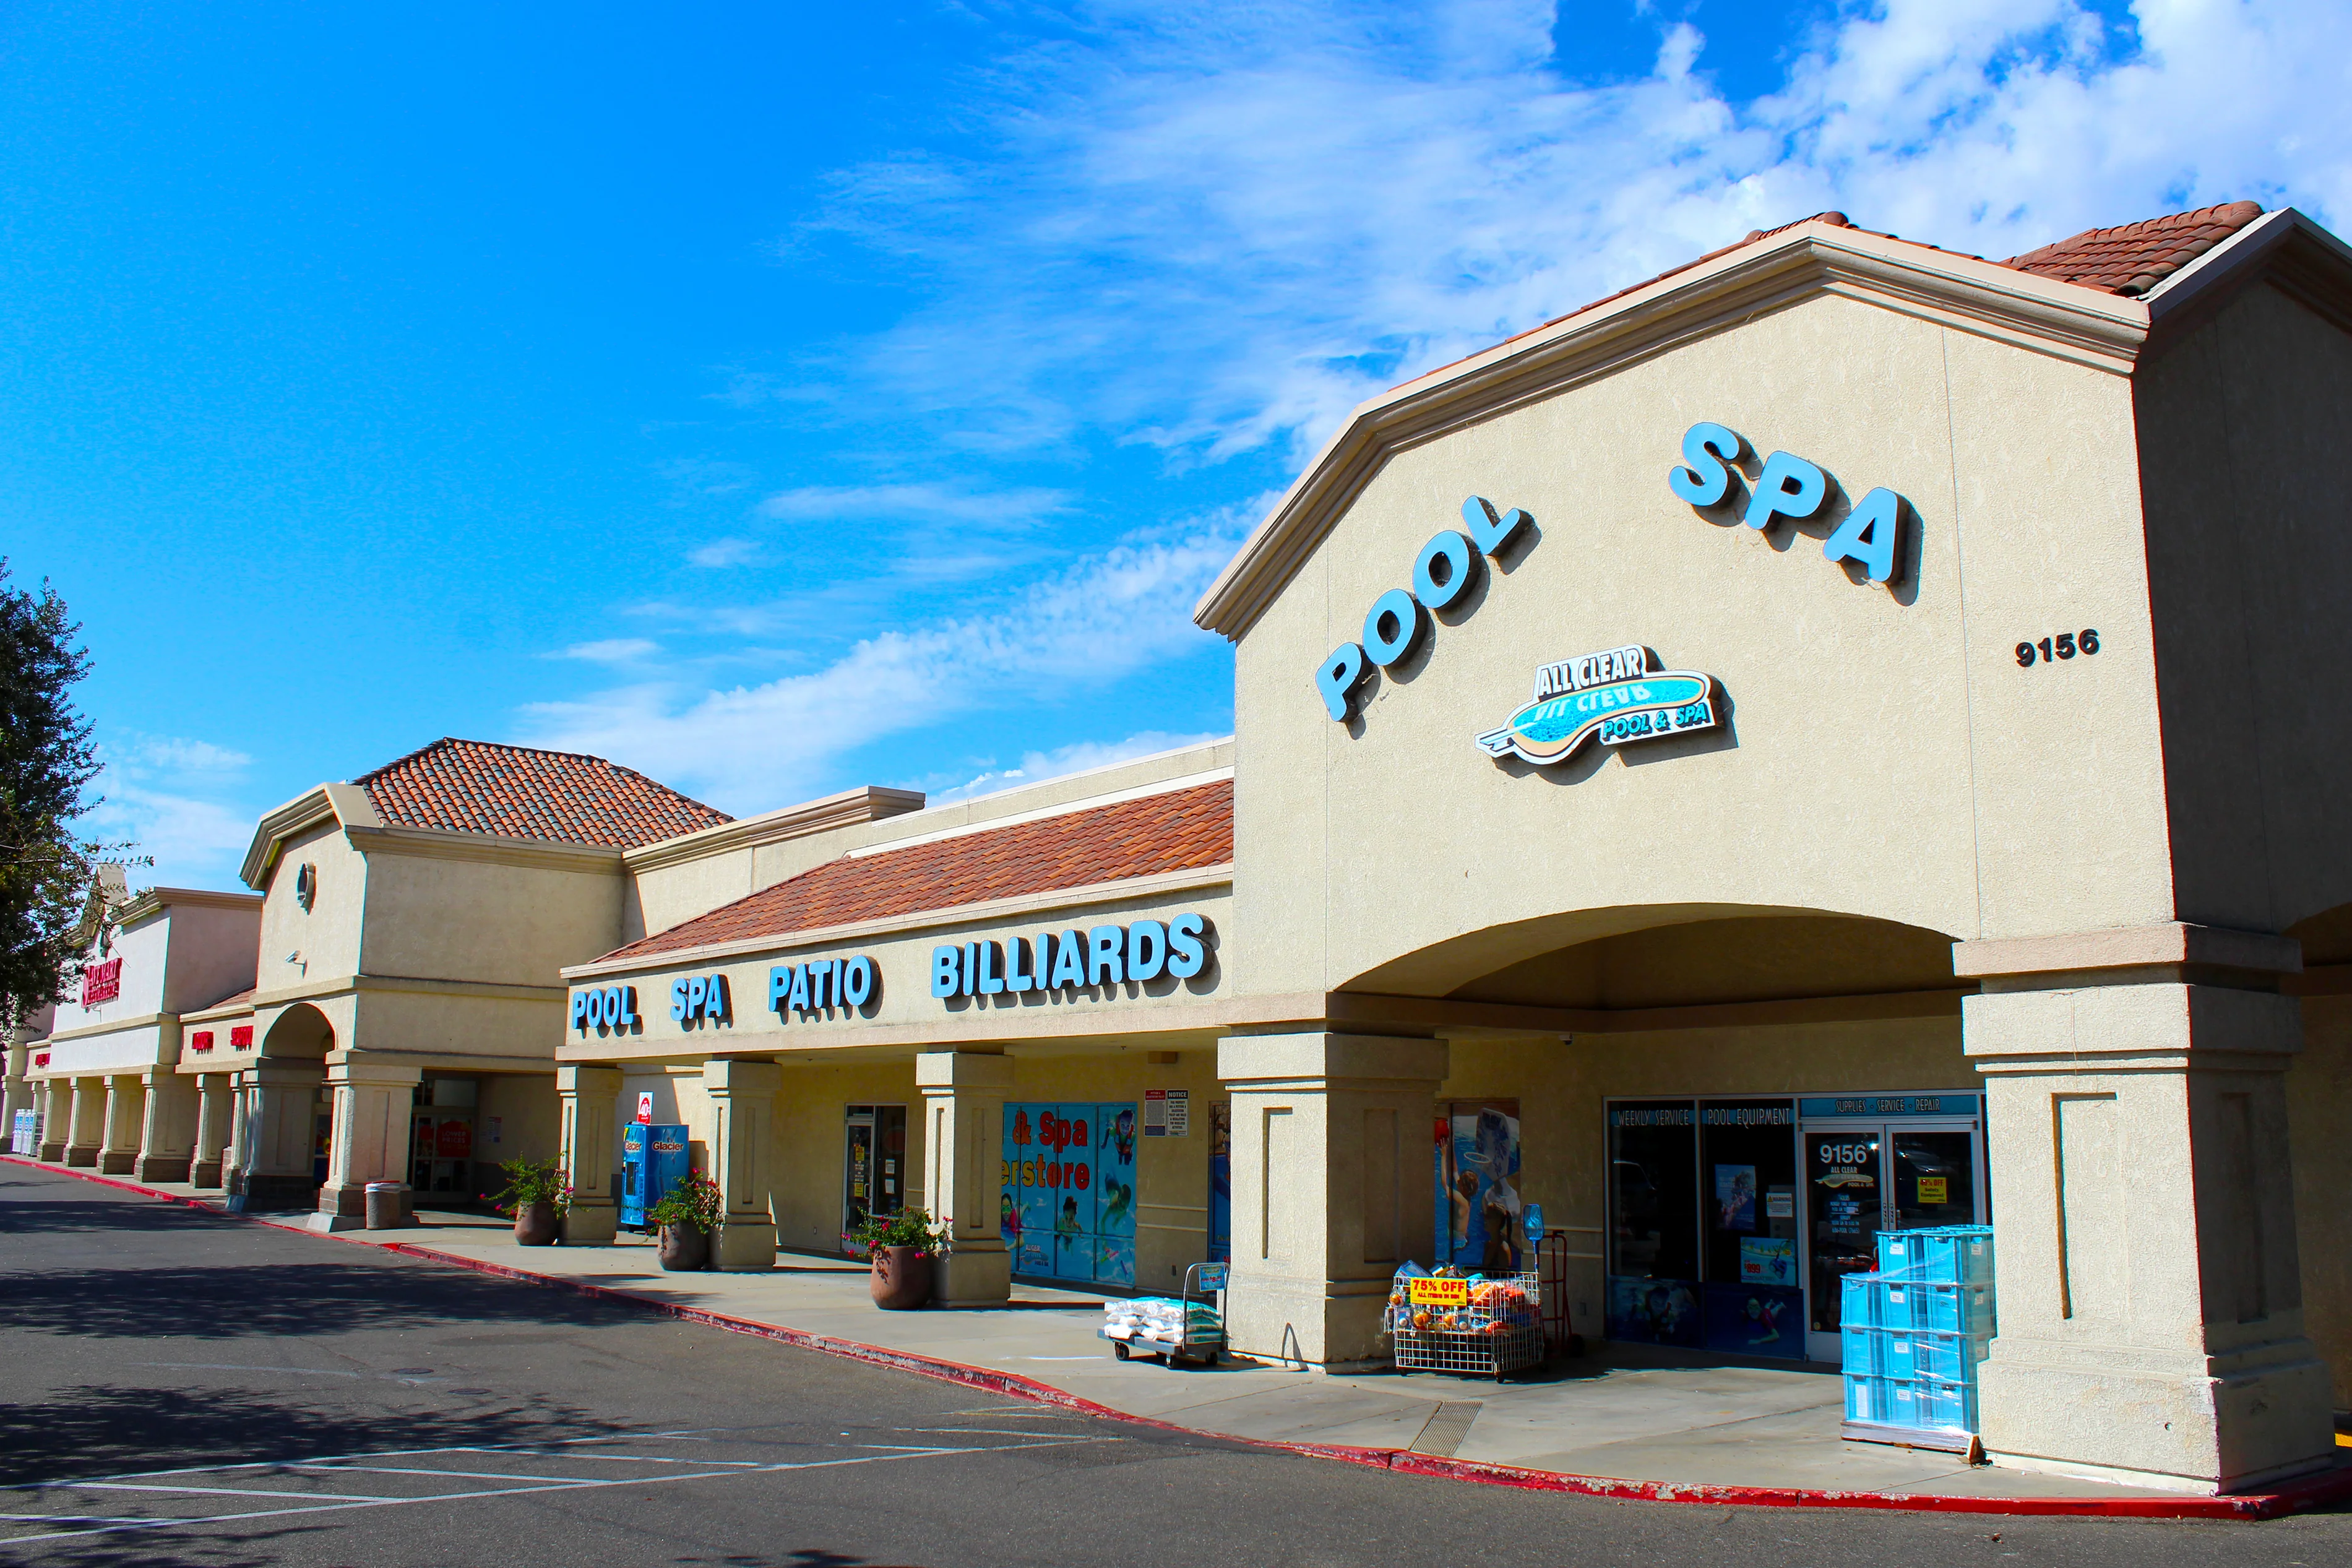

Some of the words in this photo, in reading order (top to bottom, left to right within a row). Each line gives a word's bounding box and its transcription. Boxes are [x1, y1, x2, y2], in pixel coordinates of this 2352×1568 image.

[1668, 421, 1898, 582] SPA
[1316, 495, 1520, 722] POOL
[2015, 629, 2100, 667] 9156
[1538, 663, 1572, 697] ALL
[1577, 648, 1641, 689] CLEAR
[1602, 713, 1650, 742] POOL
[1654, 710, 1669, 731] &
[1674, 703, 1710, 726] SPA
[572, 985, 635, 1030] POOL
[670, 973, 723, 1021] SPA
[769, 955, 872, 1012] PATIO
[931, 912, 1204, 998] BILLIARDS
[1617, 1109, 1651, 1126] WEEKLY
[1655, 1109, 1689, 1126] SERVICE
[1708, 1108, 1731, 1126] POOL
[1736, 1108, 1790, 1129] EQUIPMENT
[1835, 1099, 1866, 1113] SUPPLIES
[1876, 1098, 1905, 1113] SERVICE
[1915, 1098, 1941, 1112] REPAIR
[653, 1141, 684, 1150] Glacier
[1012, 1110, 1032, 1145] &
[1038, 1111, 1088, 1153] Spa
[1820, 1144, 1867, 1163] 9156
[1413, 1280, 1437, 1291] 75%
[1441, 1282, 1465, 1293] OFF
